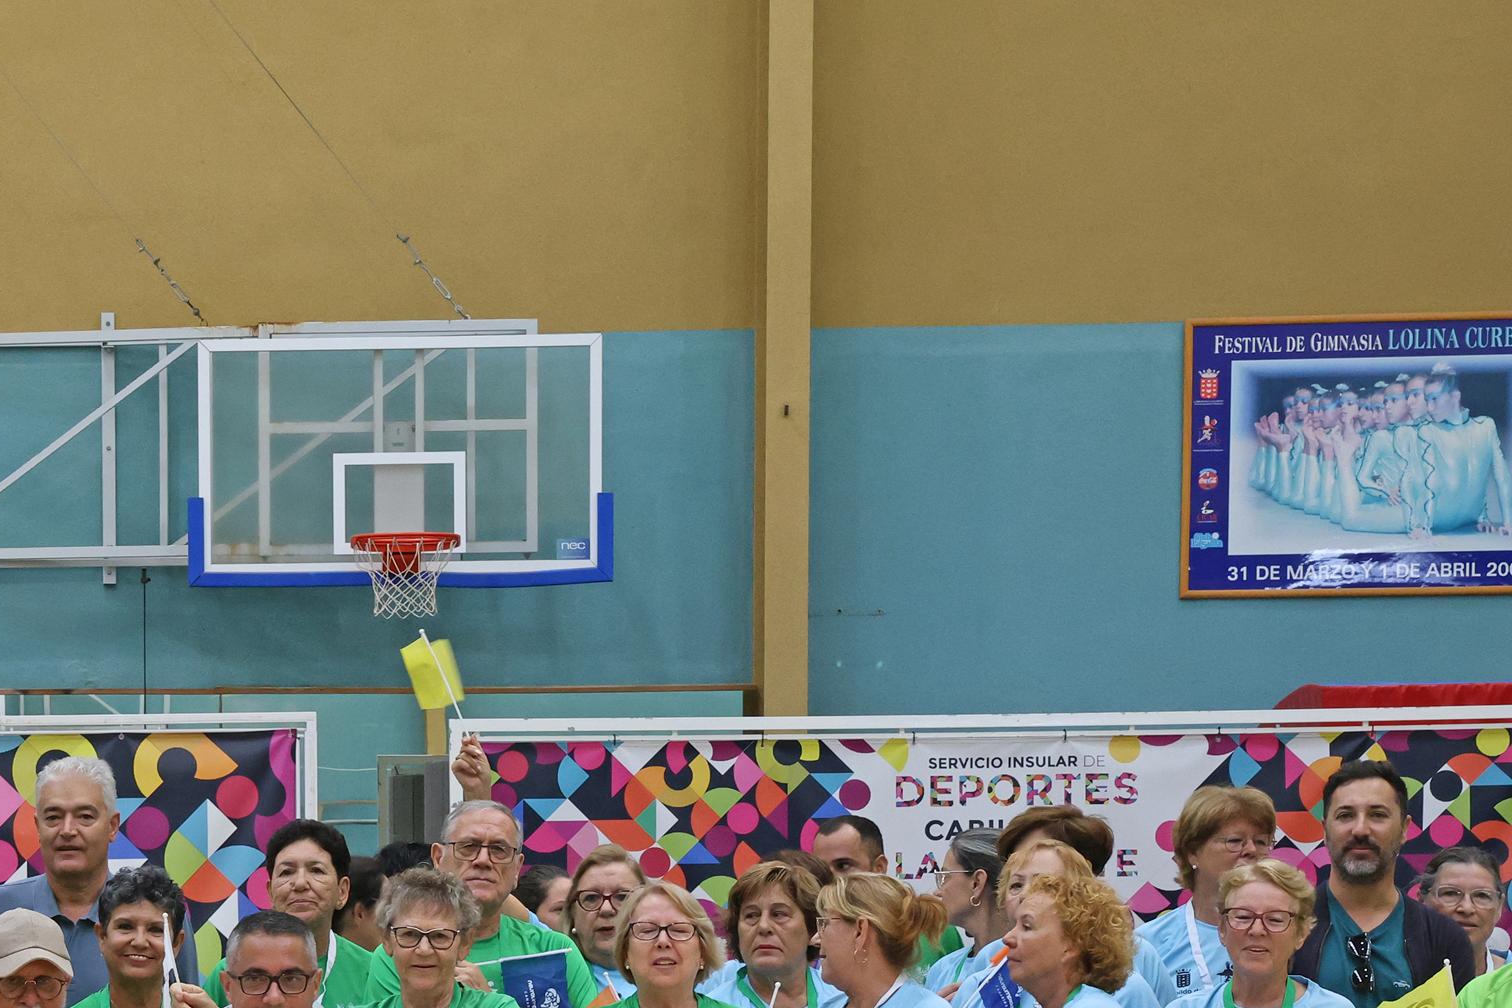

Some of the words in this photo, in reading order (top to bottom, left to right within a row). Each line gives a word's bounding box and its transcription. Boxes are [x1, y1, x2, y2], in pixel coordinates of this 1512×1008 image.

[1214, 335, 1282, 354] FESTIVAL
[1286, 335, 1305, 353] DE
[1310, 332, 1383, 352] GIMNASIA
[1388, 327, 1460, 350] LOLINA
[561, 542, 586, 550] nec
[1227, 567, 1248, 581] 31
[1255, 566, 1280, 580] DE
[1287, 565, 1355, 580] MARZO
[1361, 564, 1373, 579] Y
[1379, 564, 1387, 578] 1
[1397, 563, 1420, 578] DE
[1425, 562, 1481, 578] ABRIL
[928, 757, 1003, 769] SERVICIO
[1008, 756, 1078, 769] INSULAR
[1083, 755, 1105, 768] DE
[895, 772, 1139, 808] DEPORTES
